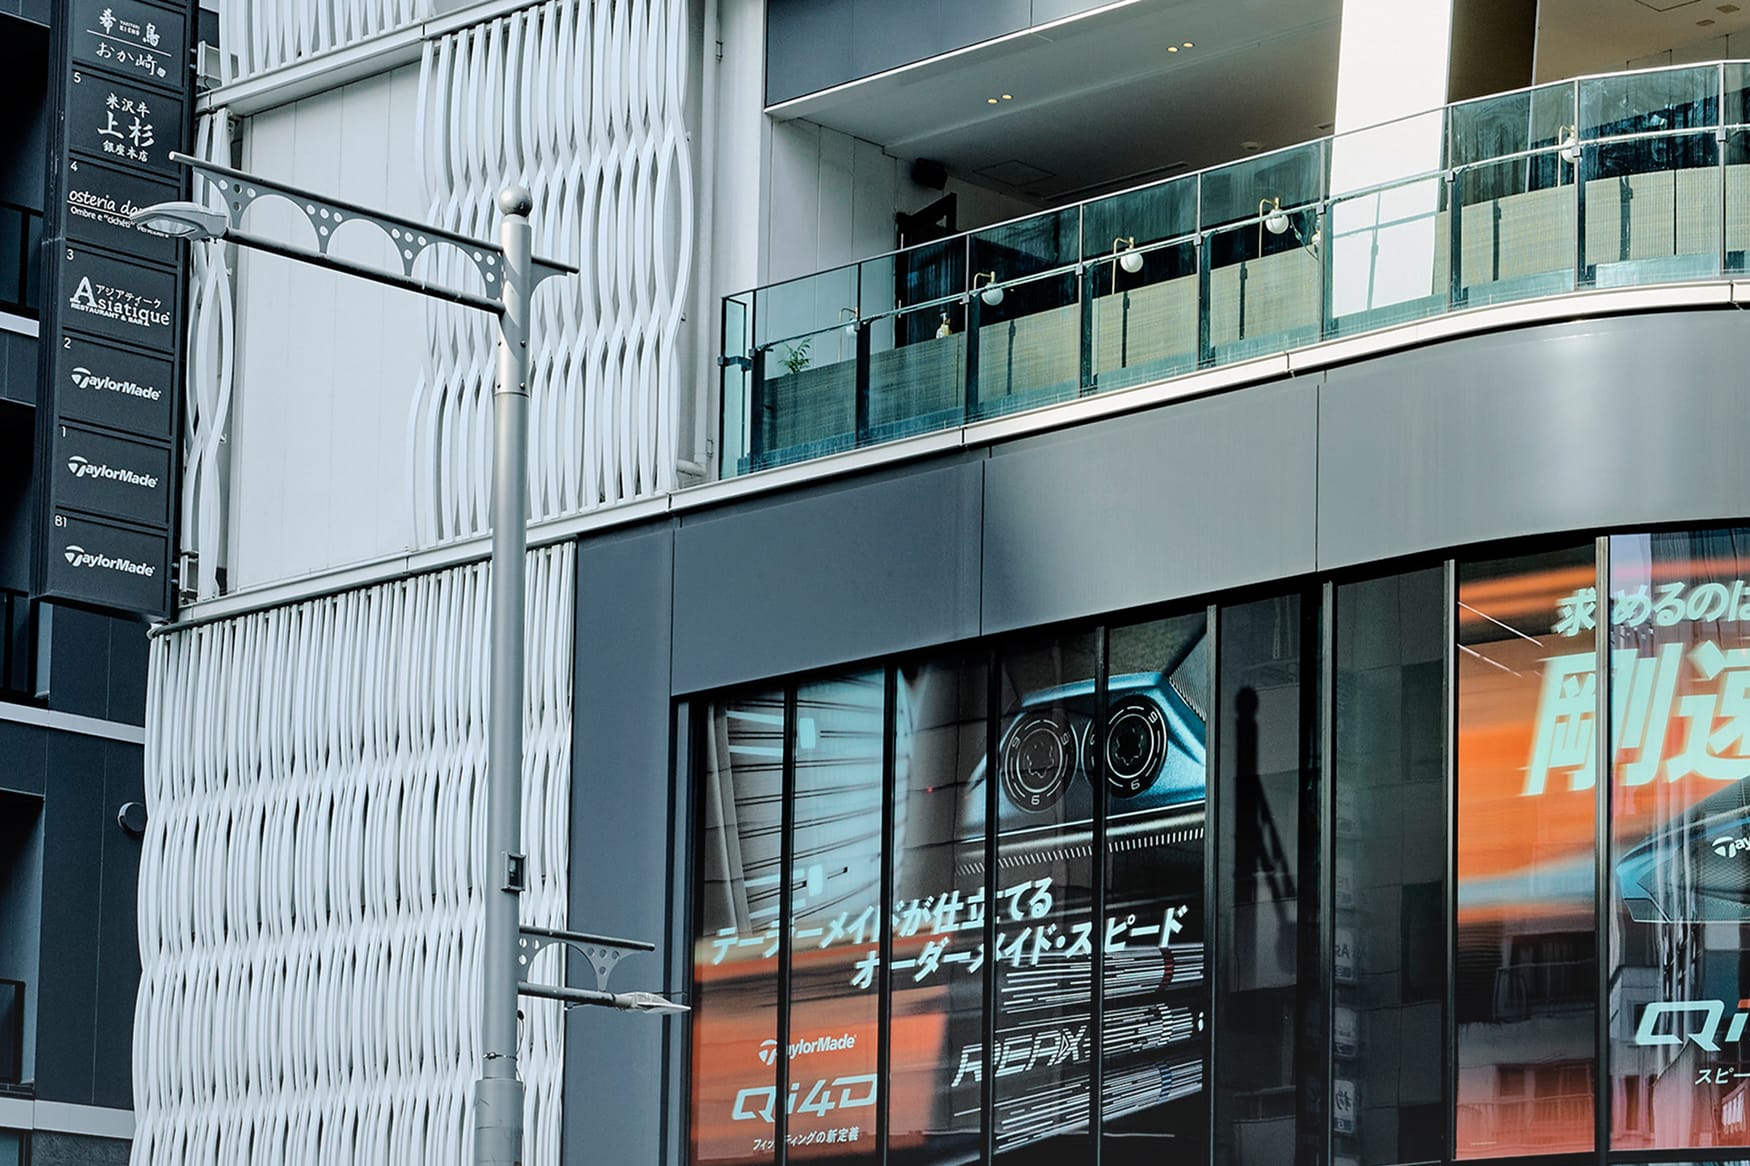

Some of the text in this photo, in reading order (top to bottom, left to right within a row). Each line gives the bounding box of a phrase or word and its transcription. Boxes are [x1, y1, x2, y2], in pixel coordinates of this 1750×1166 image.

[73, 72, 81, 83] 5
[106, 92, 150, 118] 米沢牛
[97, 110, 154, 147] 上杉
[70, 160, 78, 172] 4
[69, 190, 116, 211] osteria
[66, 249, 74, 261] 3
[70, 276, 170, 326] Asiatique
[95, 284, 161, 309] アジアティーク
[63, 337, 72, 349] 2
[71, 366, 161, 400] TaylorMade
[61, 426, 67, 438] 1
[67, 455, 158, 488] TaylorMade
[64, 544, 155, 577] TaylorMade
[732, 1073, 878, 1124] Qi4D
